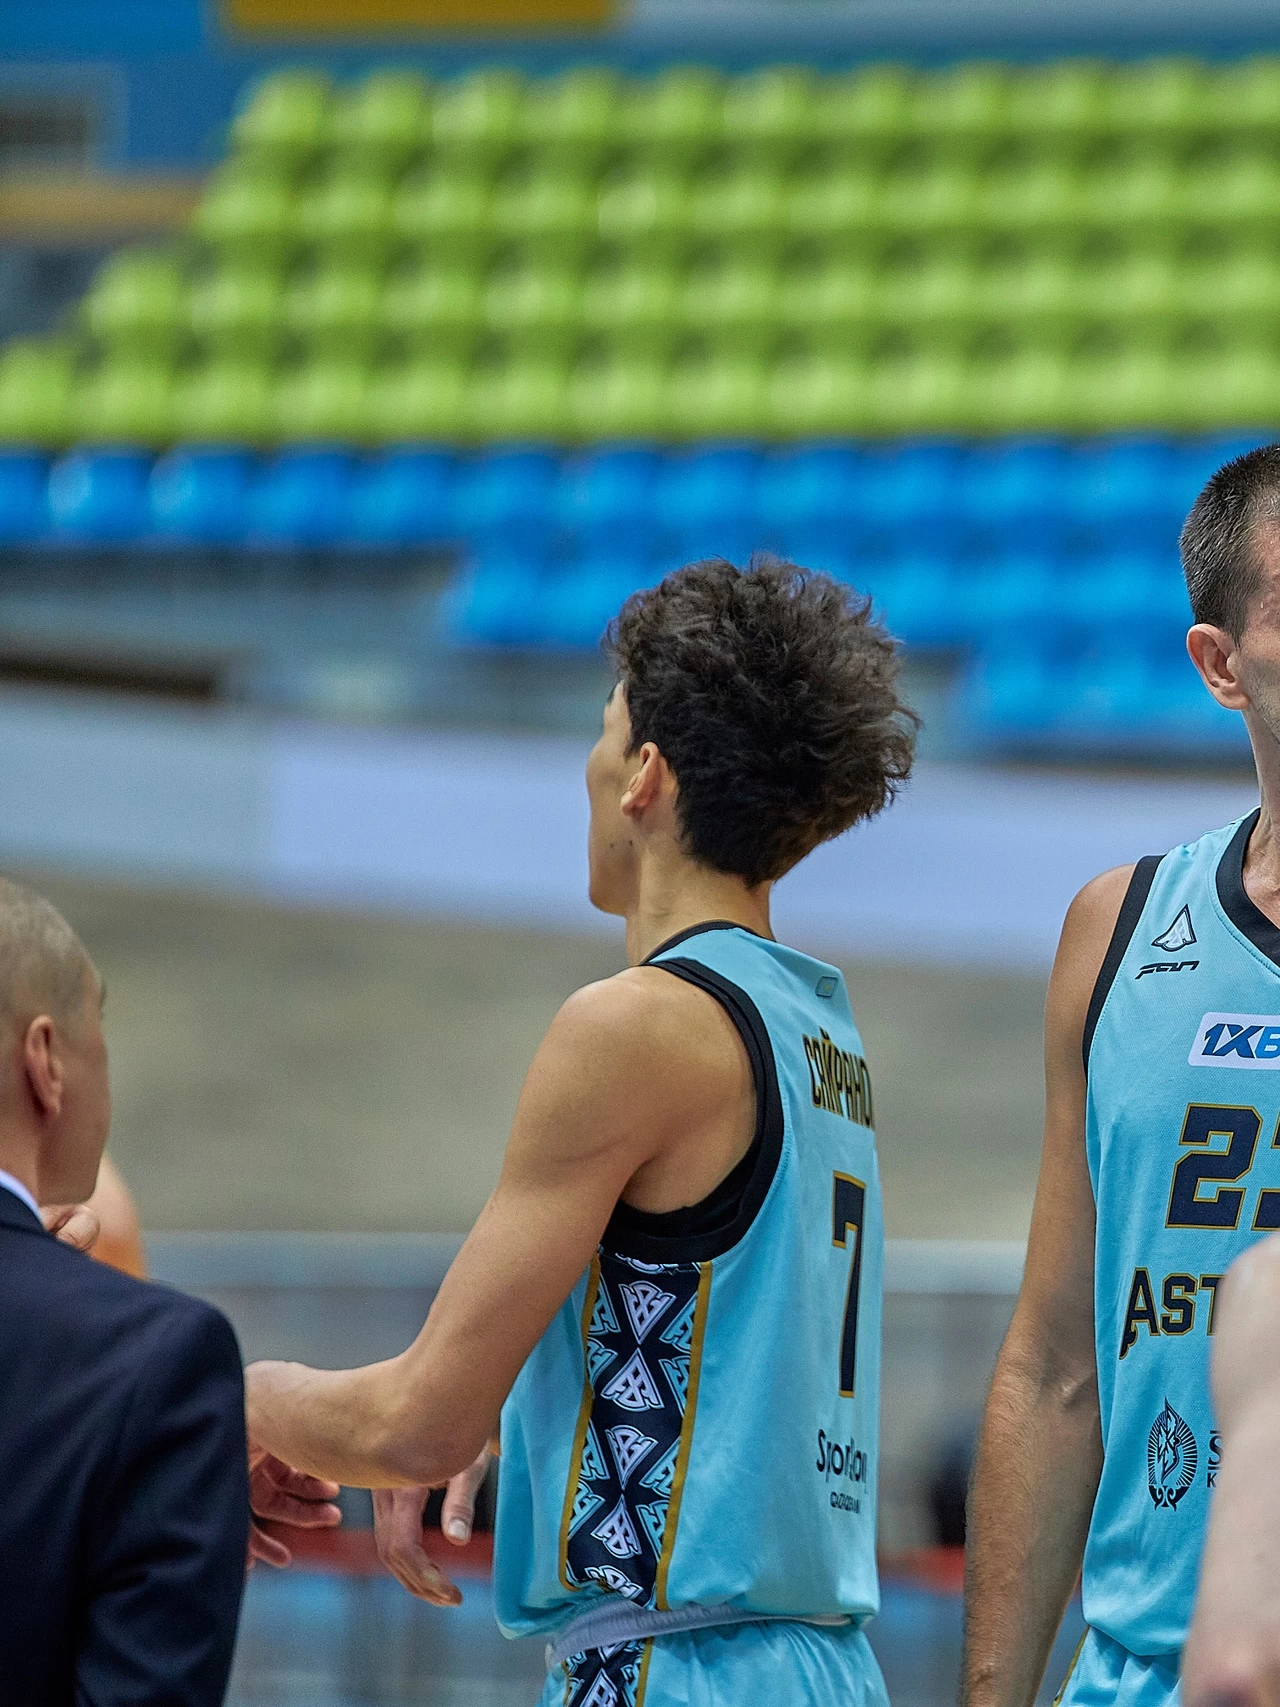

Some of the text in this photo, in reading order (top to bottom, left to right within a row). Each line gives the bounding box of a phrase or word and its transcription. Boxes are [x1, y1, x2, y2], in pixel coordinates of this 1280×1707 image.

[801, 1026, 875, 1130] САЙРАНО
[832, 1169, 866, 1399] 7
[1118, 1267, 1226, 1360] AST
